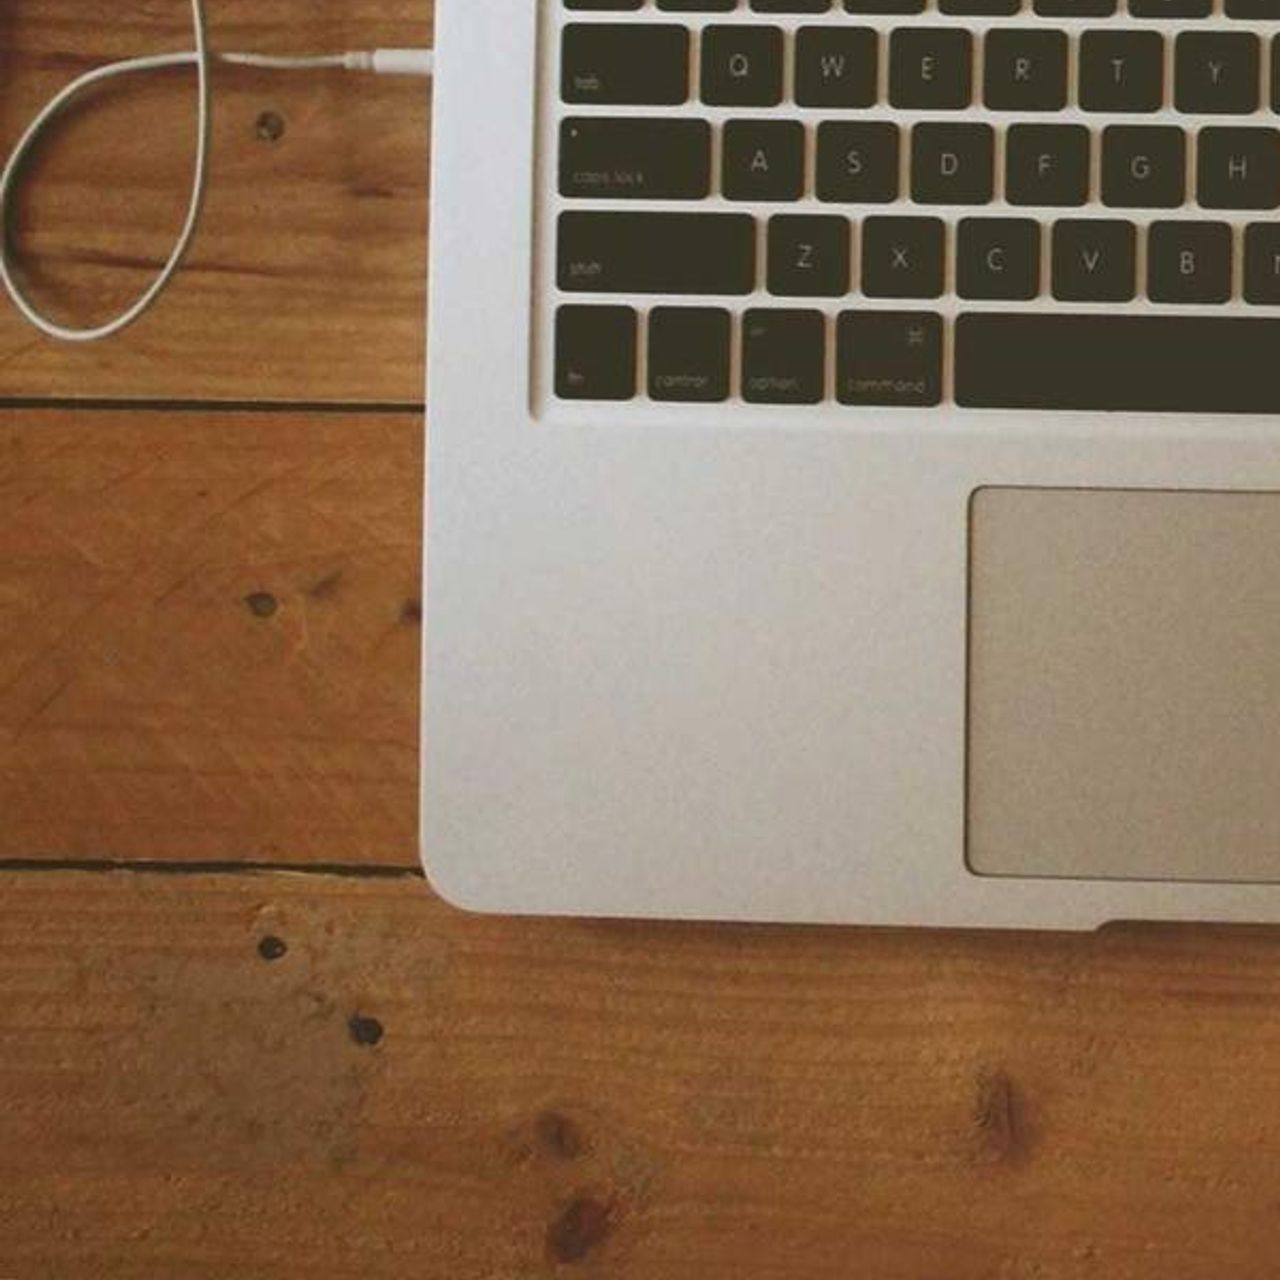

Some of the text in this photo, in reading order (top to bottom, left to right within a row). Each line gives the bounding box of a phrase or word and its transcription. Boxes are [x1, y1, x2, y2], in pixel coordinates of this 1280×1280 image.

[729, 53, 749, 77] Q
[821, 56, 845, 77] W
[921, 56, 933, 80] E
[1015, 58, 1030, 80] R
[1111, 59, 1124, 82] T
[1208, 61, 1221, 82] Y
[750, 149, 769, 172] A
[846, 150, 862, 174] S
[941, 153, 958, 175] D
[1038, 153, 1051, 173] F
[1130, 155, 1150, 179] G
[1228, 156, 1247, 179] H
[796, 244, 813, 268] Z
[893, 249, 908, 267] X
[986, 247, 1003, 271] C
[1082, 251, 1100, 271] V
[1180, 250, 1195, 275] B
